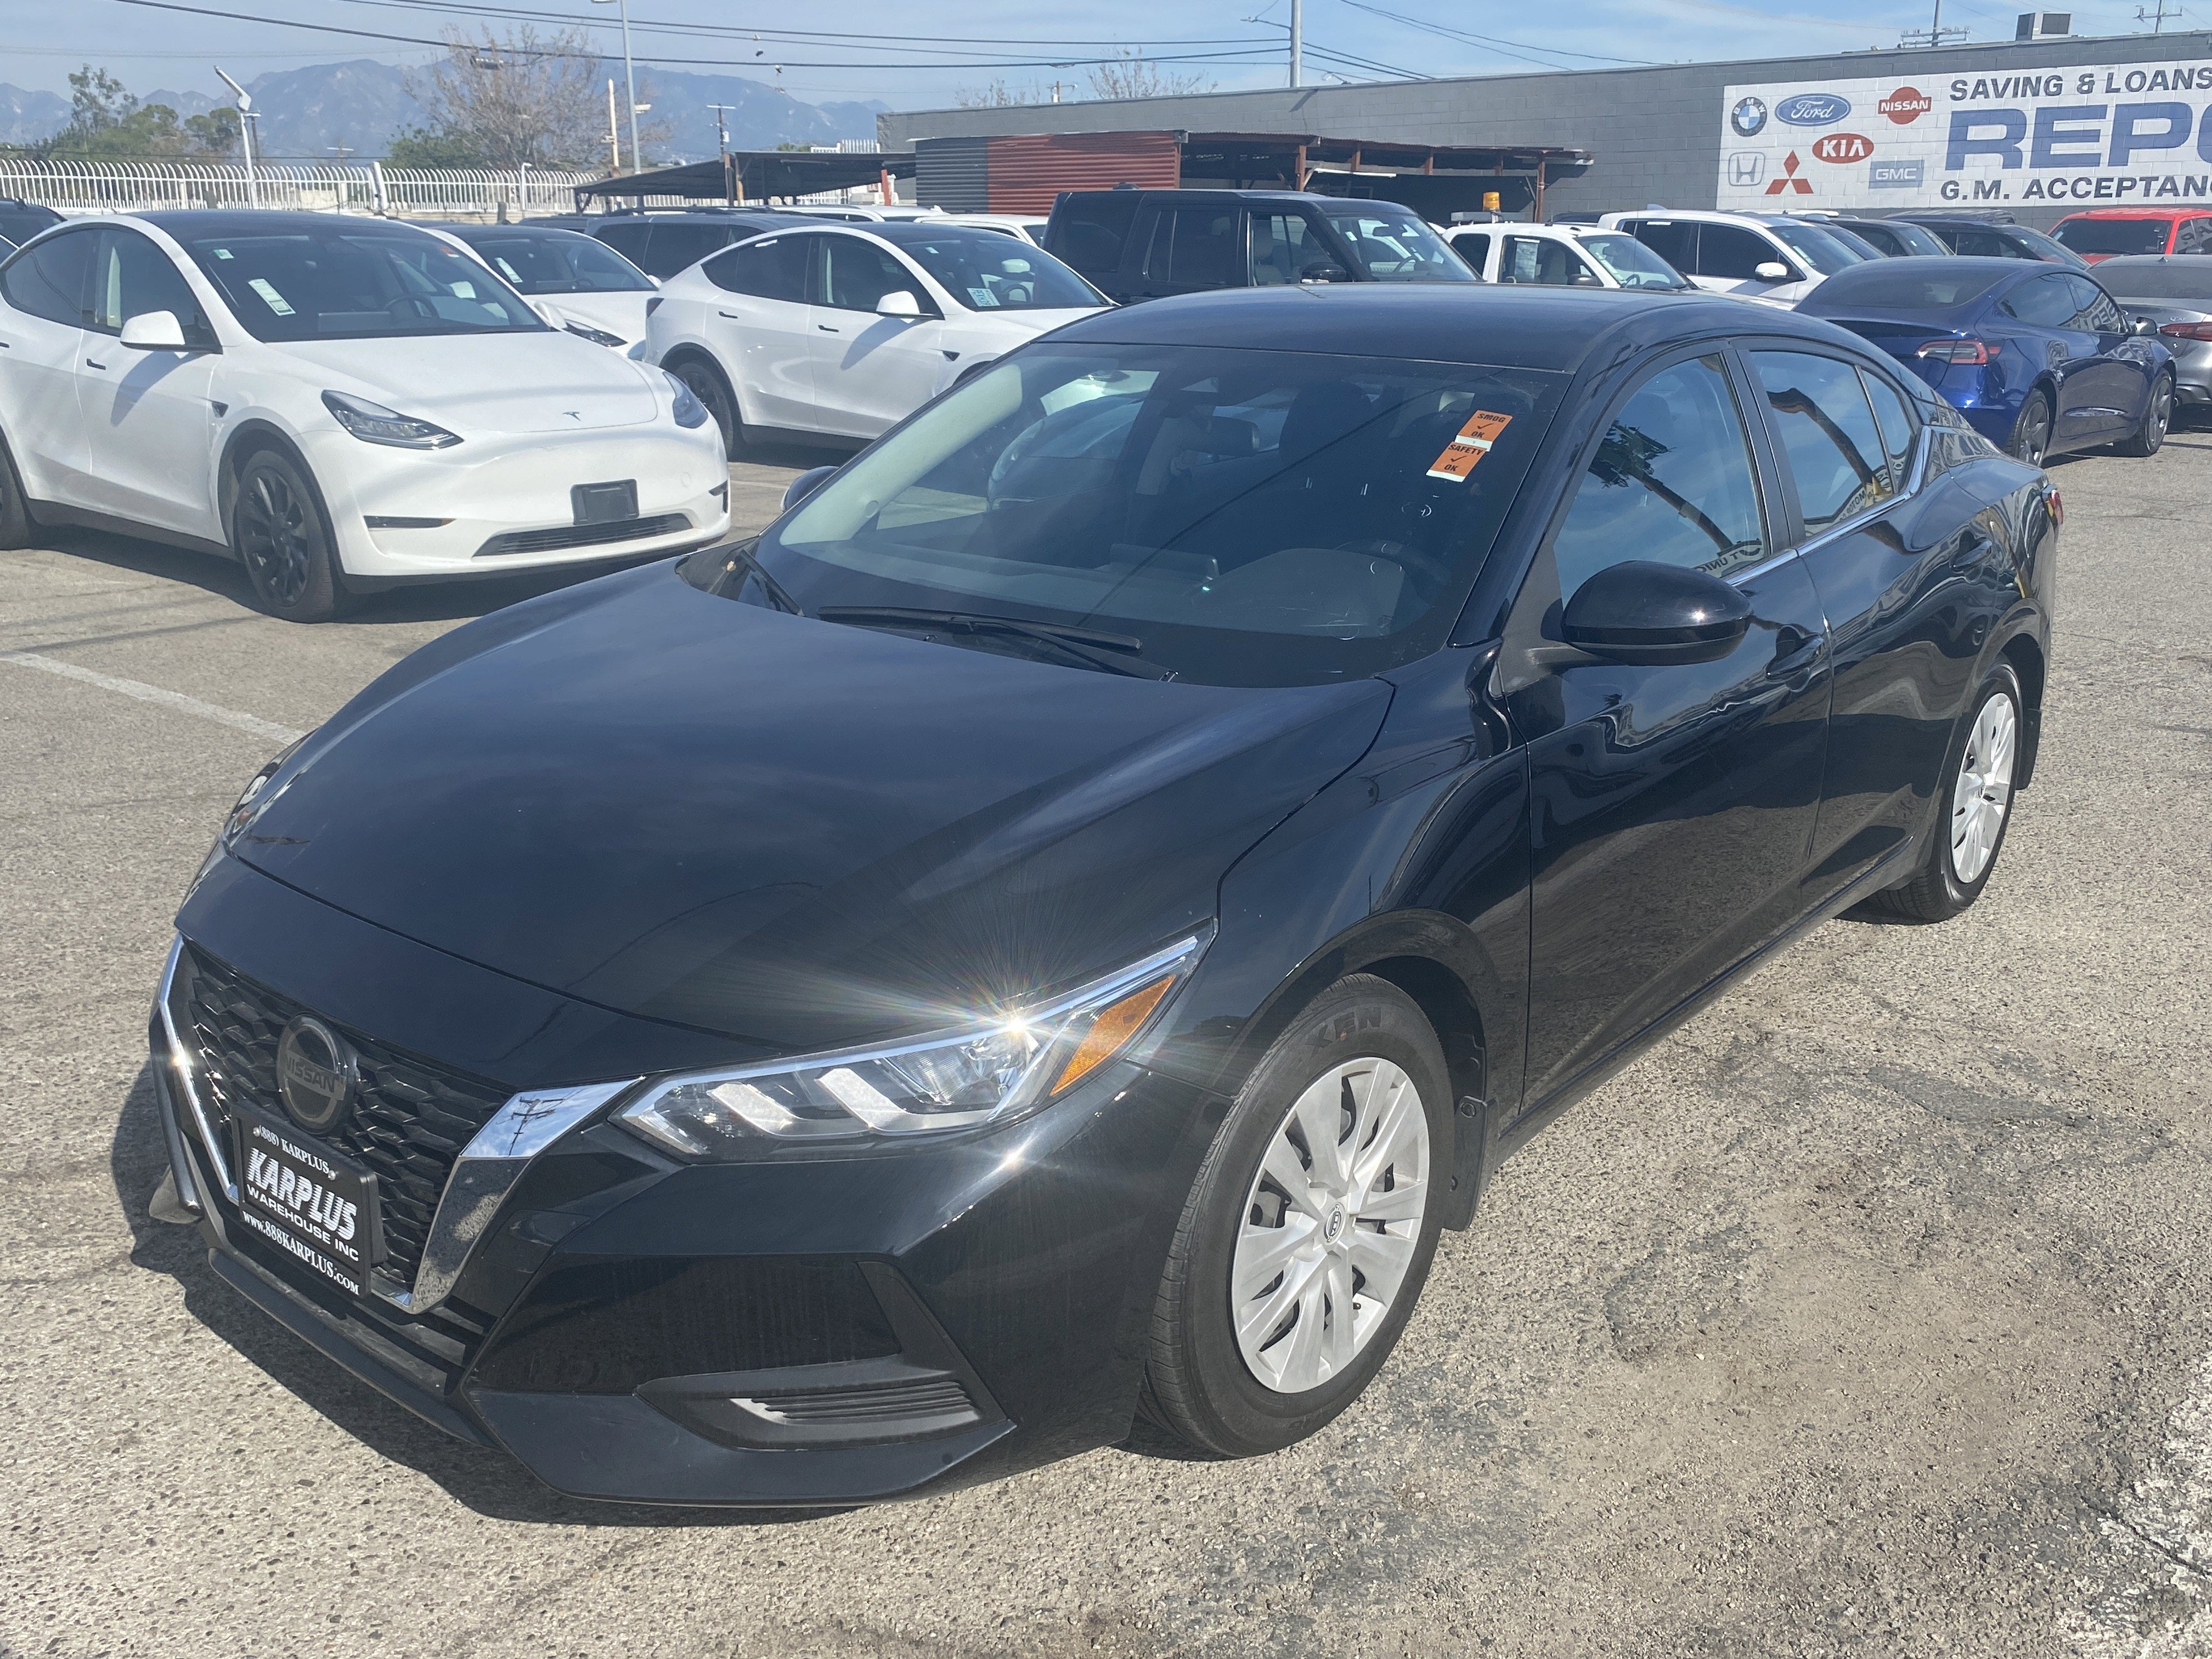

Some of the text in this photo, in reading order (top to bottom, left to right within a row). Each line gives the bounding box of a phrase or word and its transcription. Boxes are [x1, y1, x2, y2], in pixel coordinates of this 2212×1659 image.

[1950, 67, 2212, 101] SAVING & LOANS
[1734, 98, 1766, 115] BMW
[1791, 100, 1835, 119] Ford
[1881, 99, 1929, 112] NISSAN
[1945, 101, 2212, 171] REP
[1822, 139, 1865, 157] KIA
[1876, 168, 1917, 180] GMC
[1940, 175, 2212, 200] G.M. ACCEPTAN
[1477, 413, 1506, 423] SMOG
[1448, 444, 1483, 455] SAFETY
[286, 1057, 335, 1093] NISSAN
[259, 1125, 330, 1174] (888) KARPLUS
[246, 1147, 357, 1240] KARPLUS
[247, 1184, 359, 1262] WAREHOUSE INC
